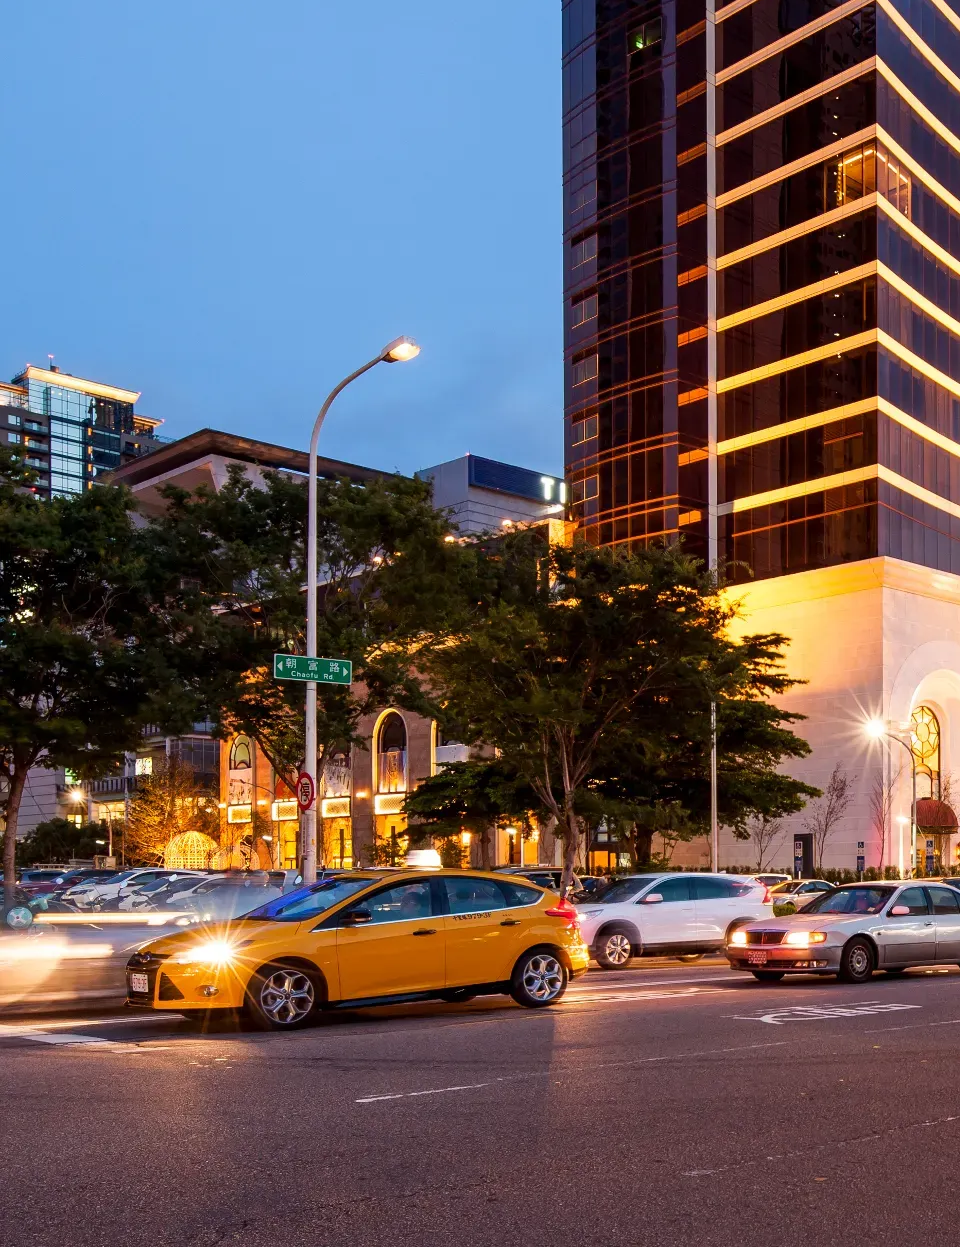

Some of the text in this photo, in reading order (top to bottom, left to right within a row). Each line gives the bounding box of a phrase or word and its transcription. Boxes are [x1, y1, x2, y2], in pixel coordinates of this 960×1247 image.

[285, 658, 340, 673] 朝富路
[290, 670, 319, 679] Chaofu
